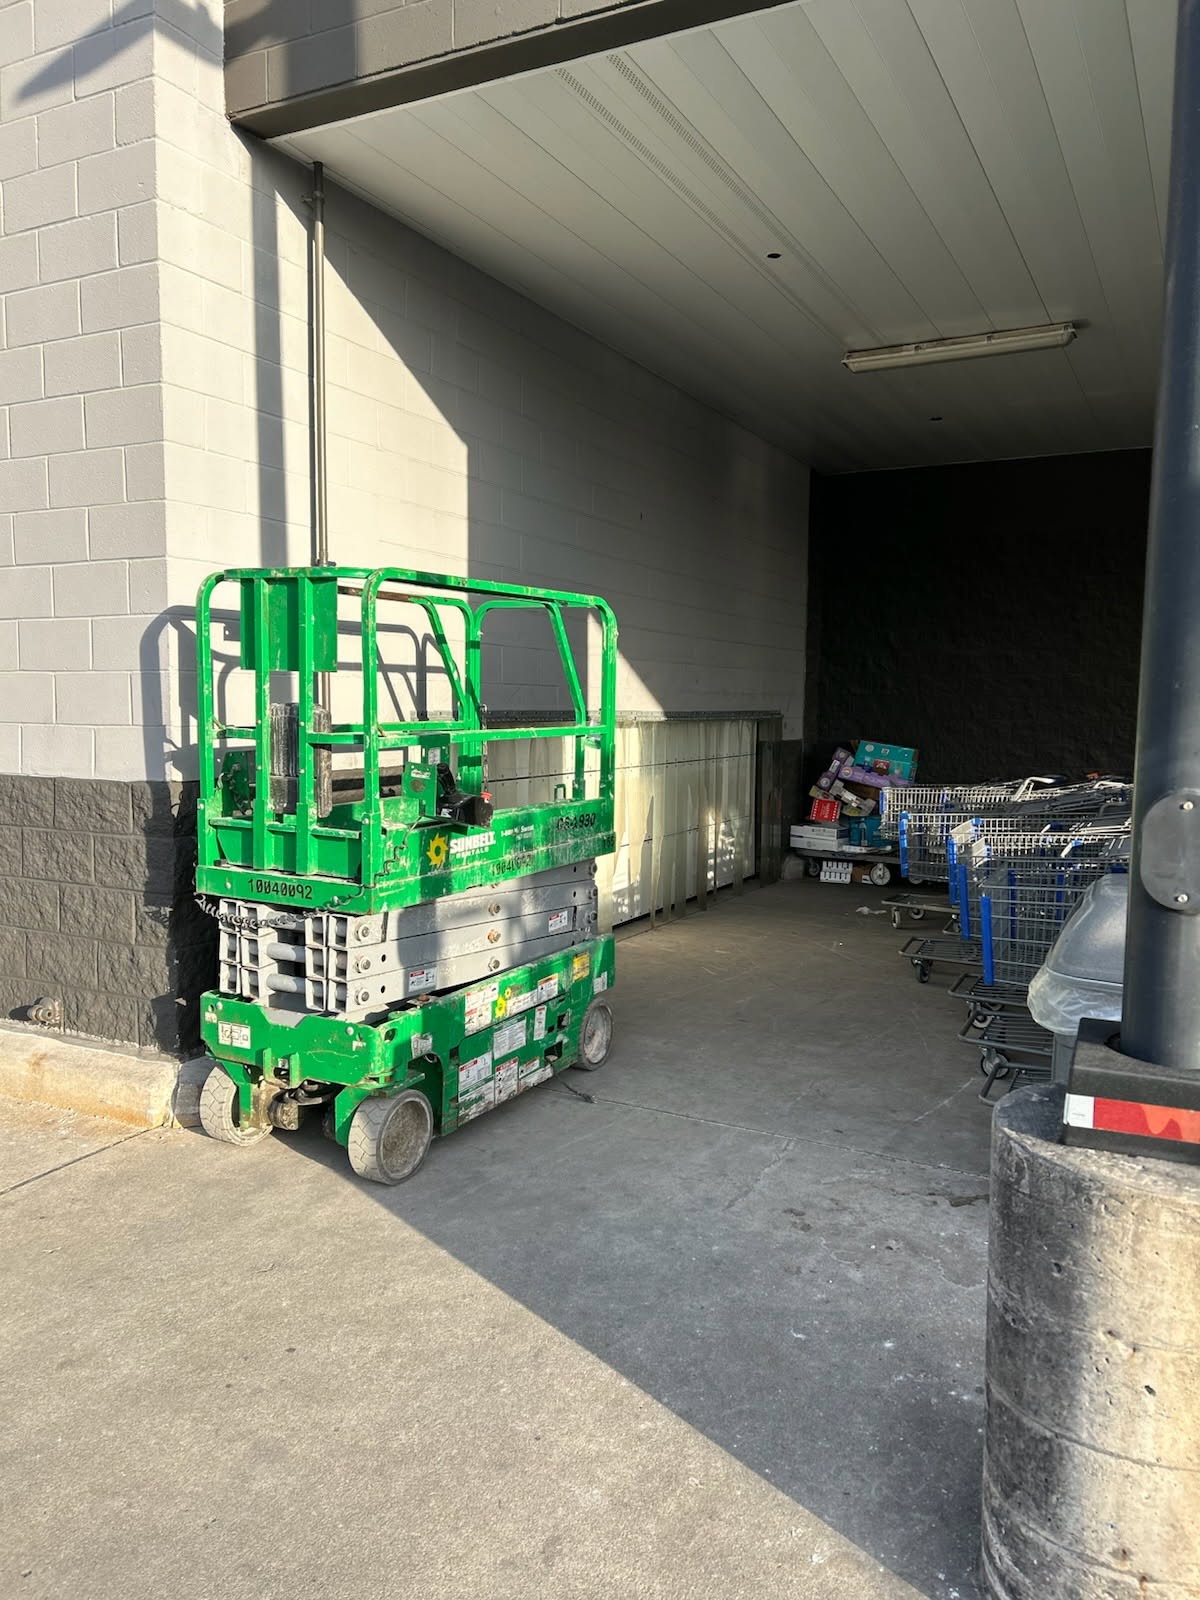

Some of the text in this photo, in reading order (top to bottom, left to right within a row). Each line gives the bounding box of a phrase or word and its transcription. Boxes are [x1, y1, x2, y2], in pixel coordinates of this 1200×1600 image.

[449, 831, 496, 854] SUNBELT
[455, 846, 490, 859] RENTALS
[248, 878, 313, 900] 10040092
